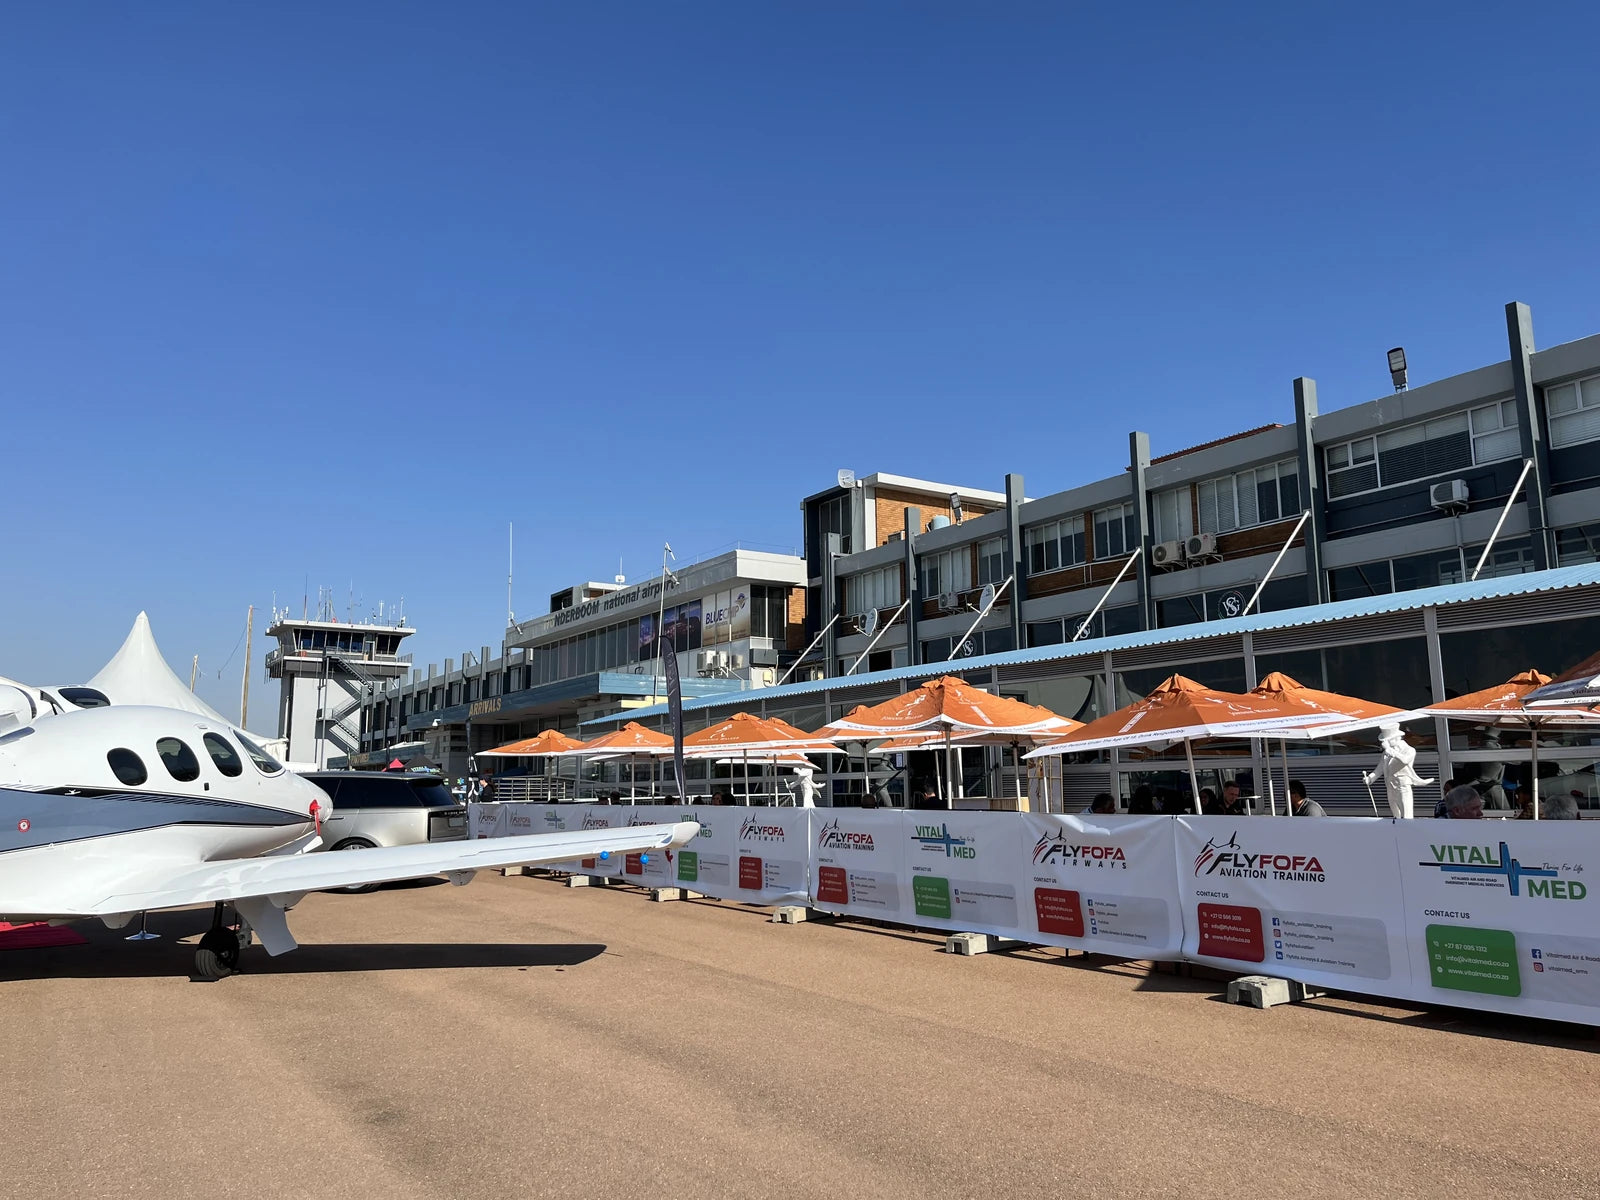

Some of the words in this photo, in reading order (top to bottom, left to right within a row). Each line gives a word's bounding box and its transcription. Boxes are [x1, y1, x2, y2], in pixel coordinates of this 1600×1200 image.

[604, 586, 640, 611] national
[469, 698, 502, 717] ARRIVALS
[744, 826, 784, 840] FLYFOFA
[915, 826, 943, 838] VITAL
[824, 832, 874, 847] FLYFOFA
[953, 846, 976, 859] MED
[1041, 844, 1125, 863] FLYFOFA
[1430, 844, 1499, 864] VITAL
[1050, 858, 1127, 869] AIRWAYS
[1206, 853, 1324, 874] FLYFOFA
[1220, 868, 1267, 879] AVIATION
[1273, 871, 1325, 882] TRAINING
[1196, 890, 1220, 898] CONTACT
[1528, 879, 1587, 900] MED
[1424, 909, 1459, 918] CONTACT
[1446, 955, 1510, 968] info@vitalmed.co.za
[1448, 968, 1509, 980] www.vitalmed.co.za
